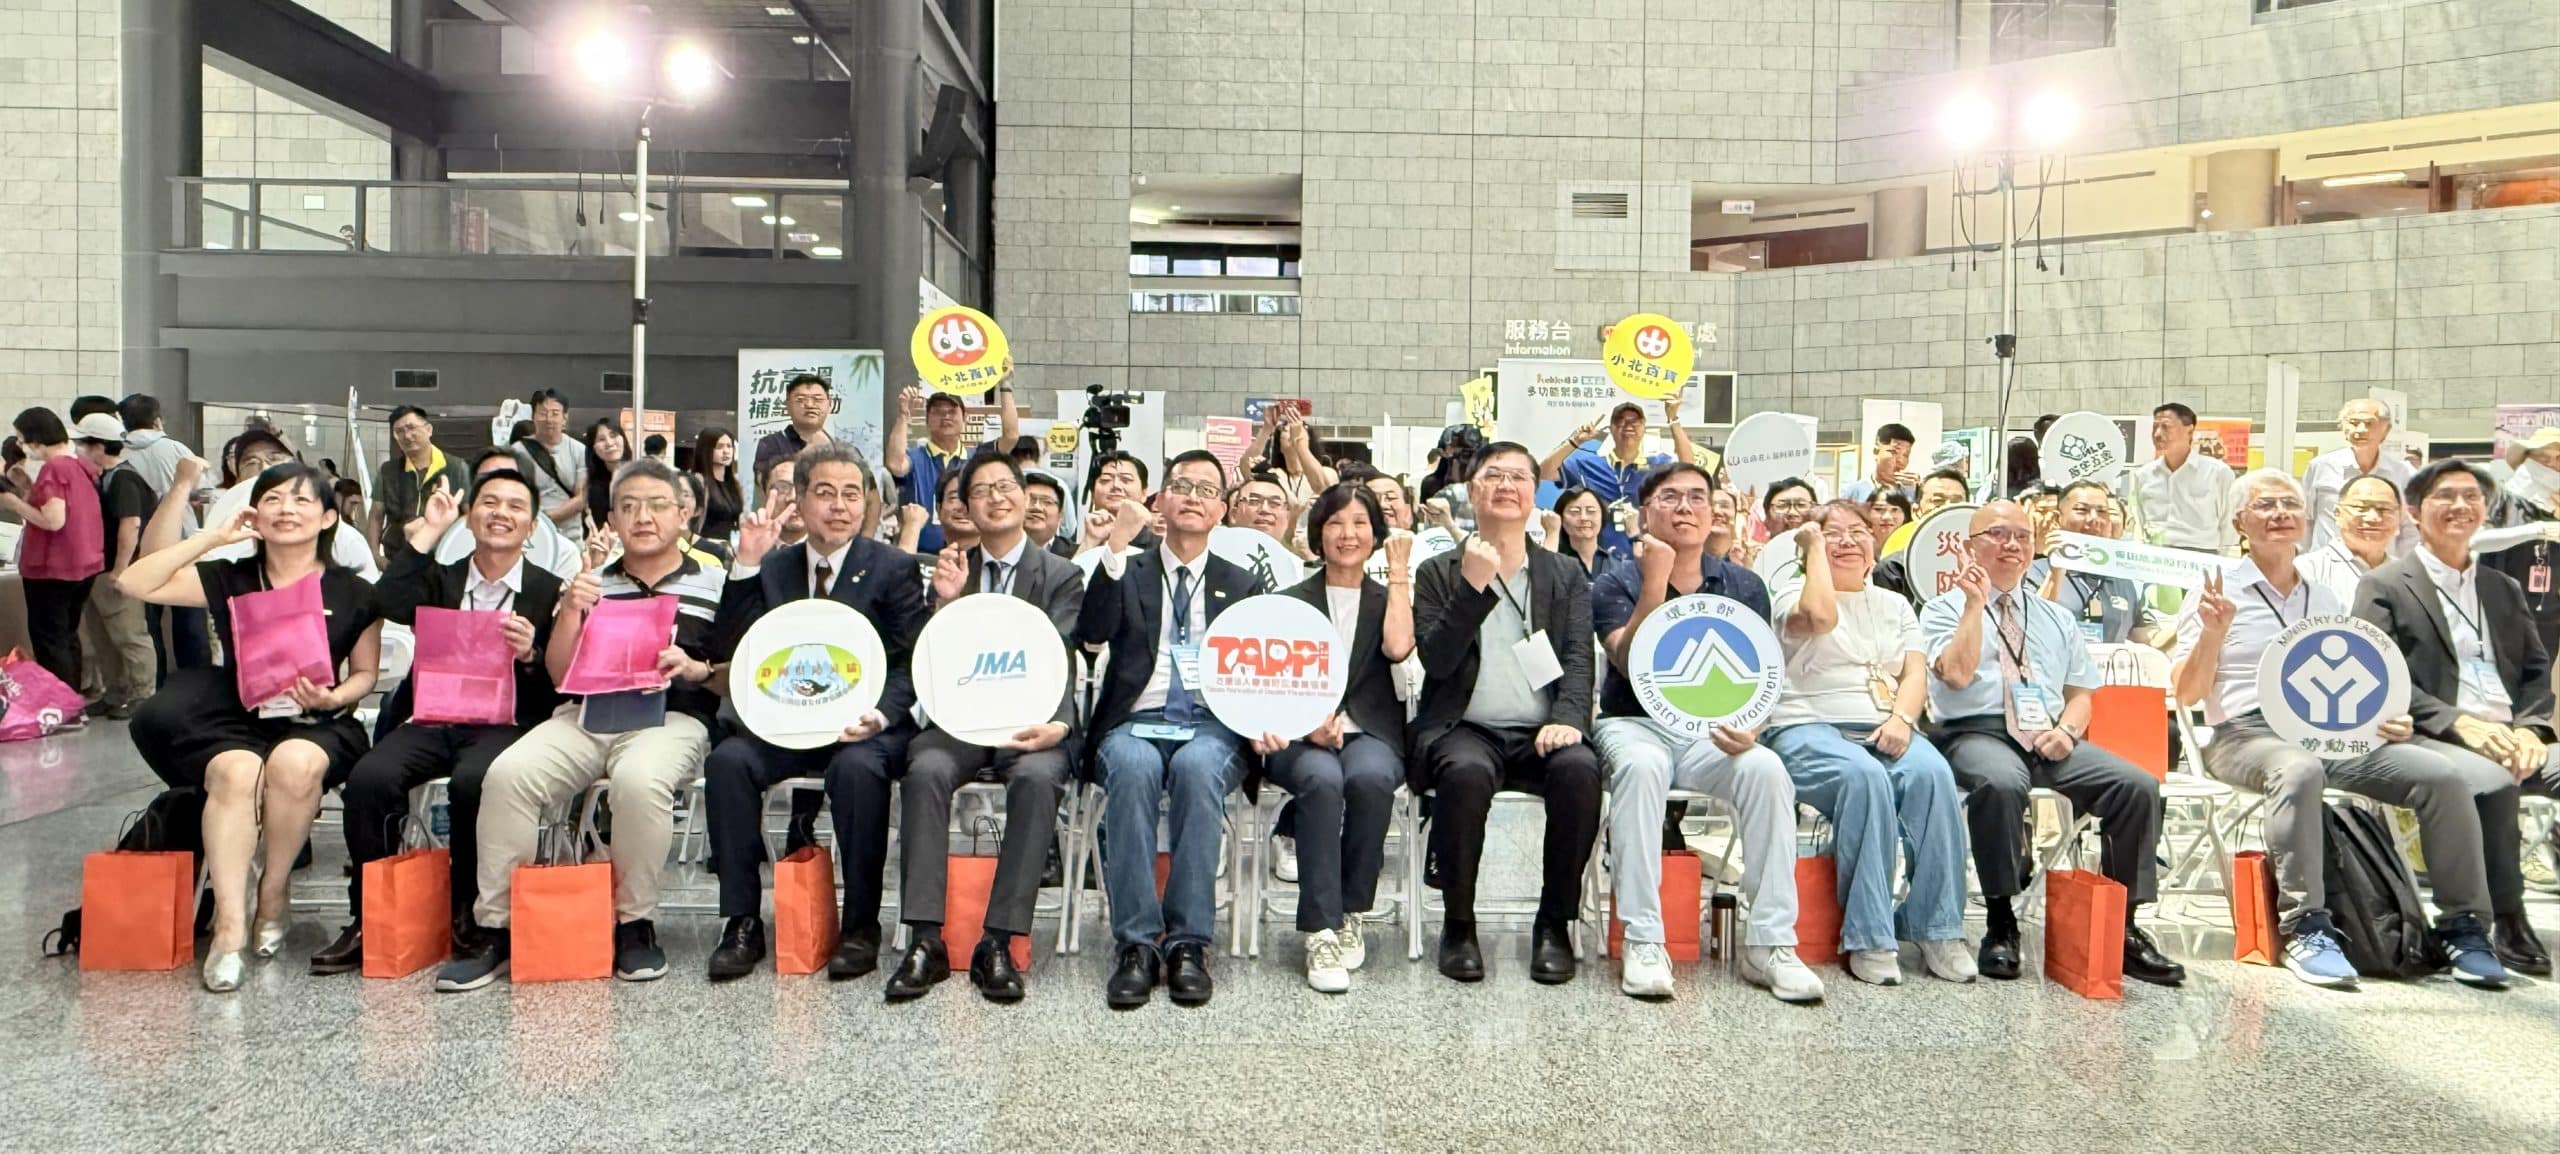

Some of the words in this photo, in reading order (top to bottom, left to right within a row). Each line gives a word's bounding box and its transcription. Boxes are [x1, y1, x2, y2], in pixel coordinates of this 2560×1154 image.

[1505, 319, 1572, 341] 服務台
[1505, 343, 1571, 357] Information
[940, 365, 997, 386] 小北百貨
[1611, 354, 1678, 384] 小北百貨
[1664, 600, 1736, 621] 環境部
[2277, 614, 2331, 648] MINISTRY
[2334, 614, 2350, 625] OF
[2355, 620, 2392, 652] LABOR
[957, 650, 1027, 686] JMA
[1637, 671, 1682, 728] Ministry
[1685, 720, 1701, 733] of
[1707, 664, 1780, 731] Evironment
[2300, 737, 2370, 755] 勞動部
